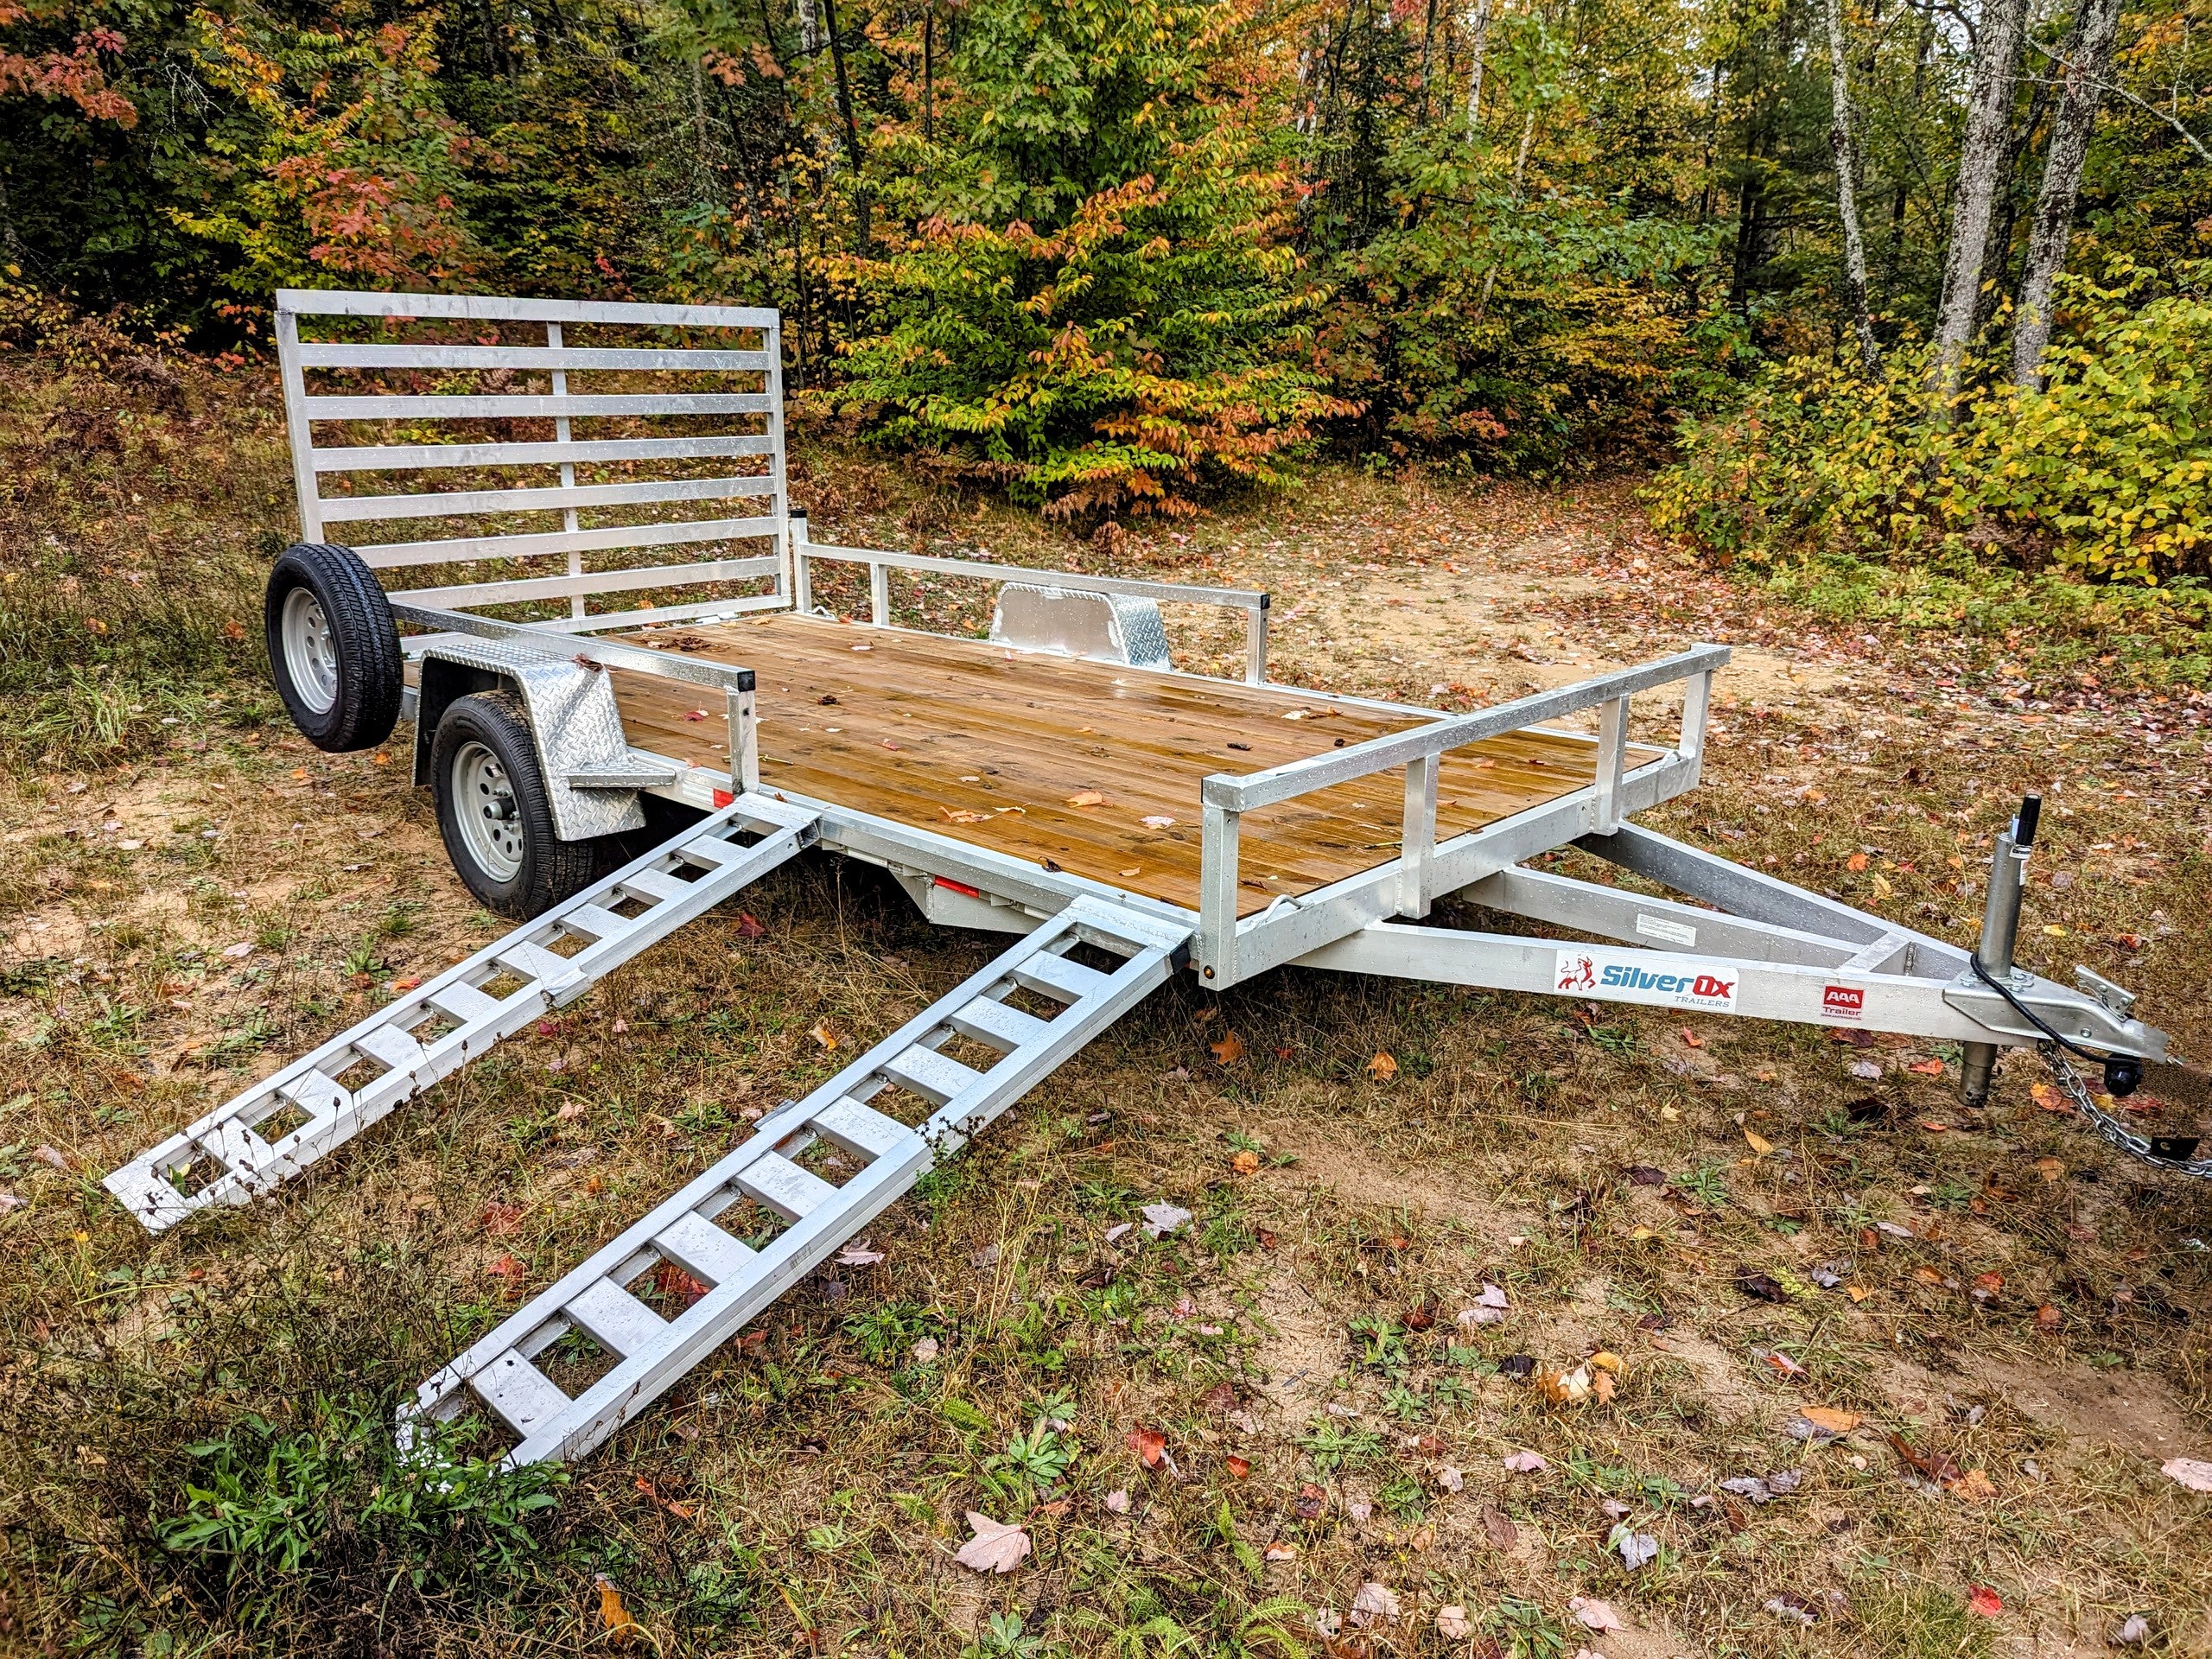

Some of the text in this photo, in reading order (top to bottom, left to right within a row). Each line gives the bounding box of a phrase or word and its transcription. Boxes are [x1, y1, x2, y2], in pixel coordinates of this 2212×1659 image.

[1675, 995, 1730, 1008] TRAILERS
[1826, 991, 1860, 1004] AAA
[1822, 1006, 1861, 1016] Trailer
